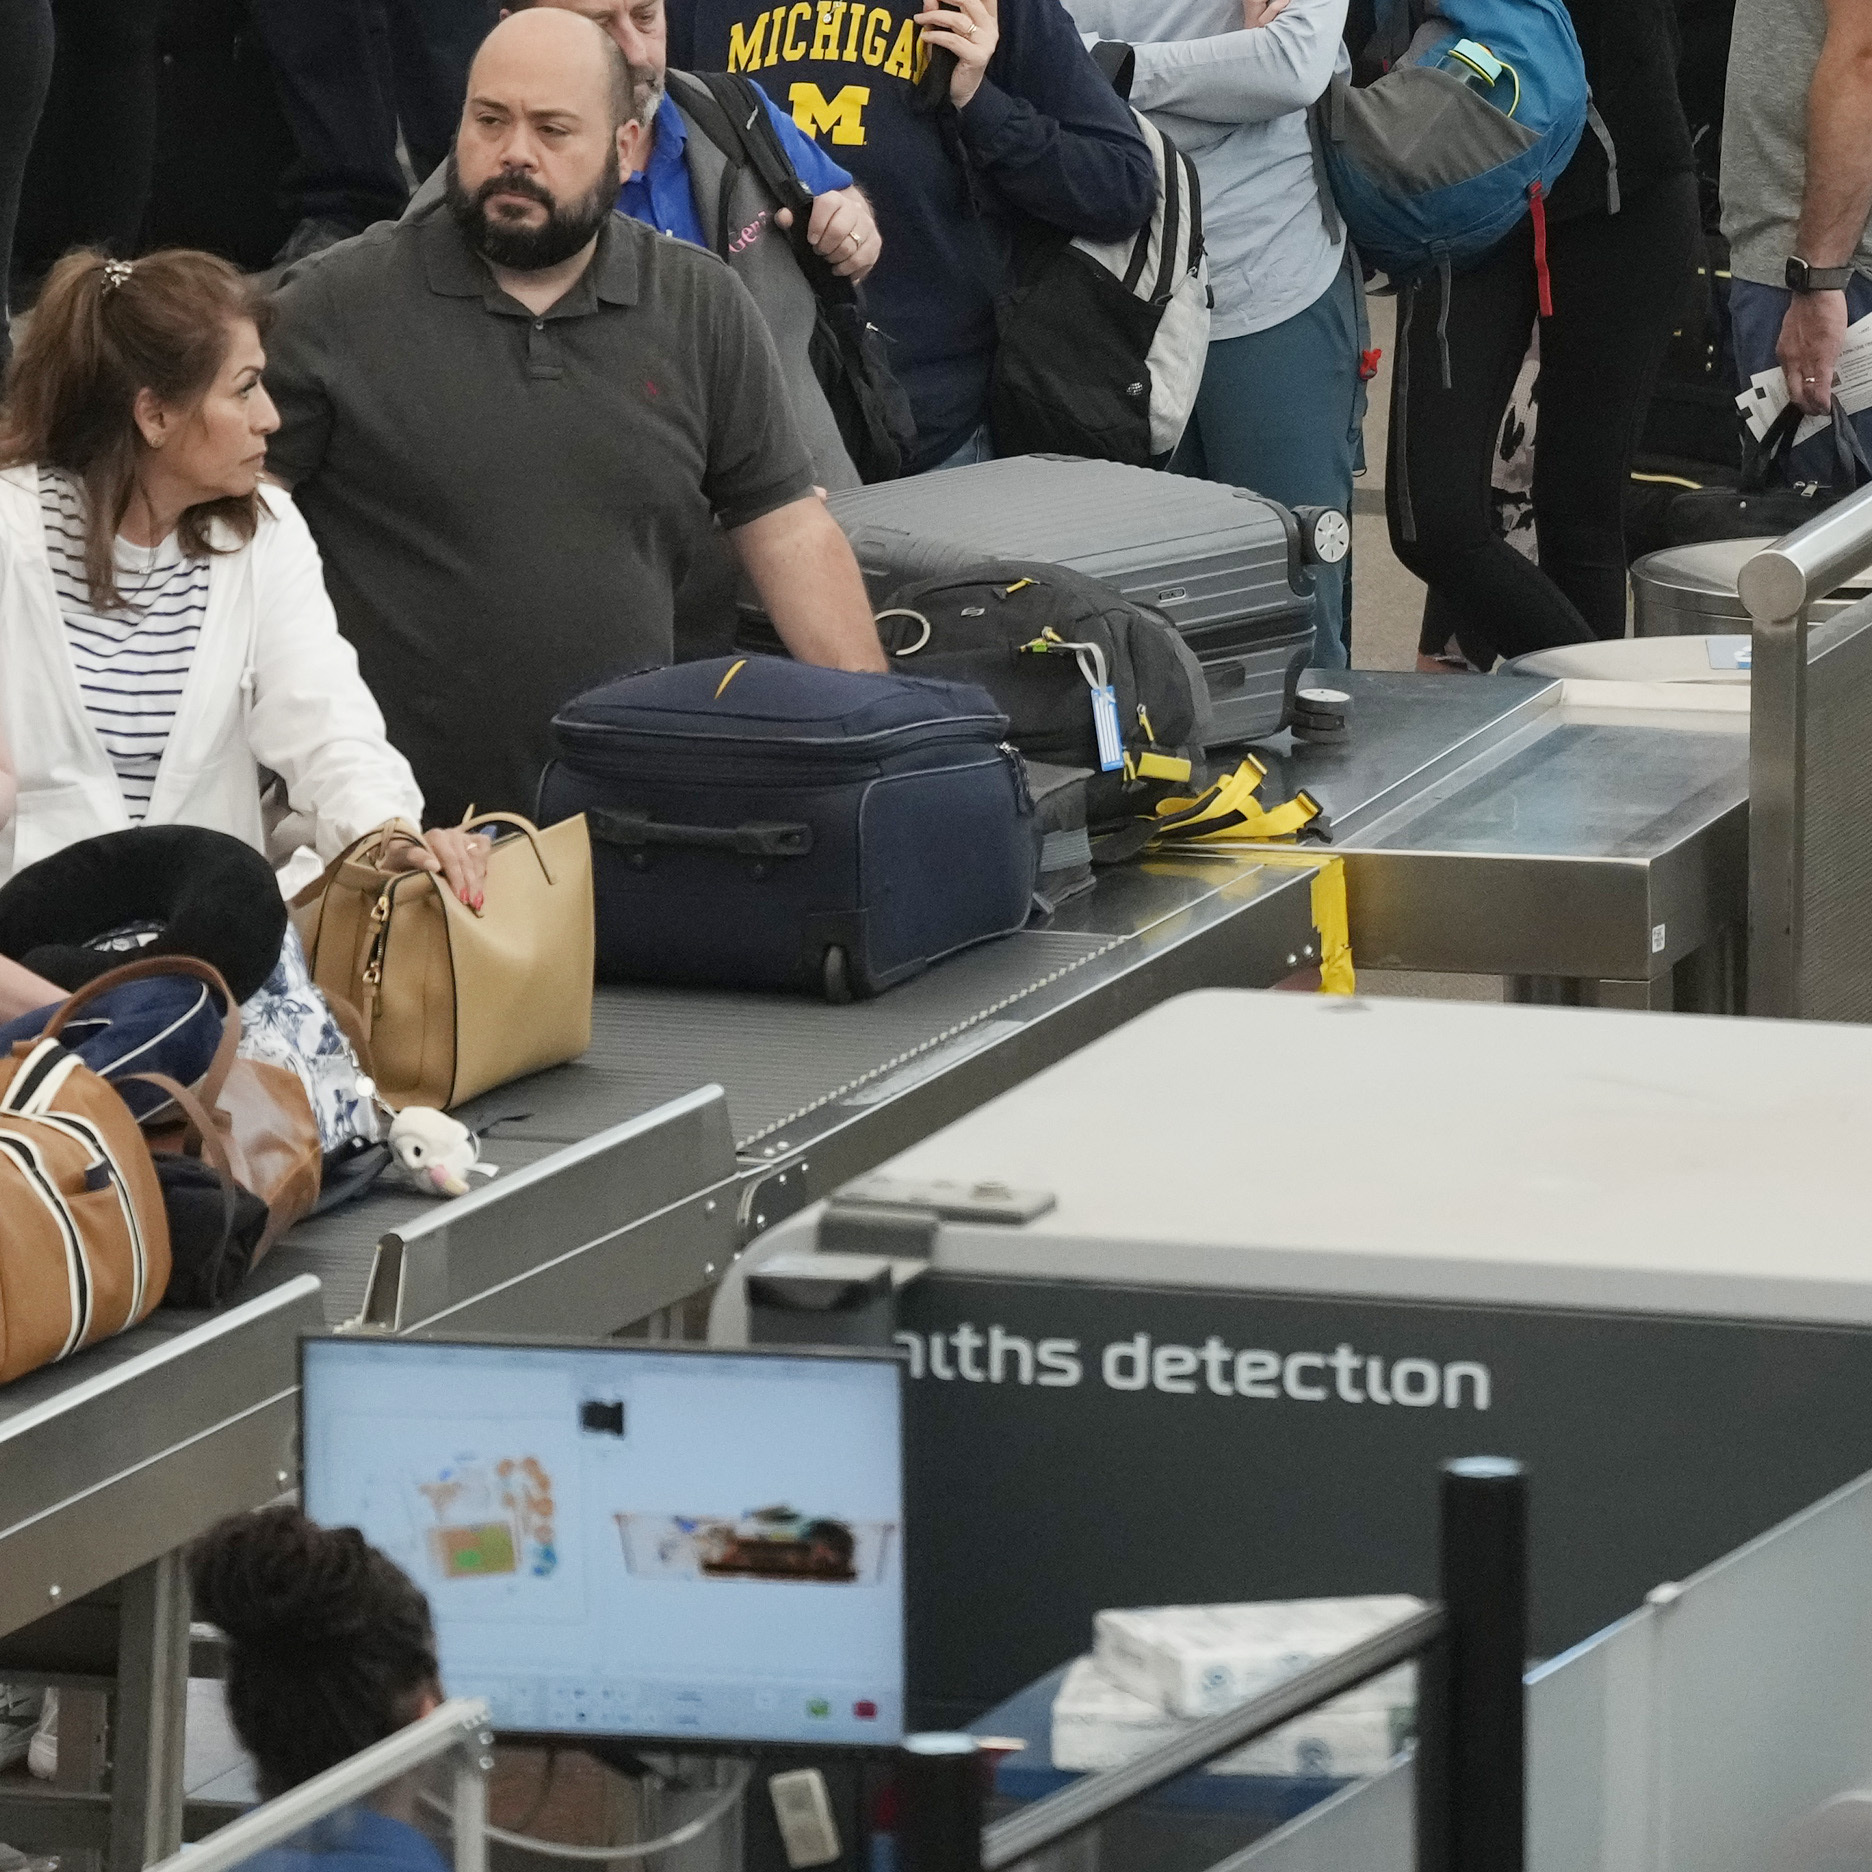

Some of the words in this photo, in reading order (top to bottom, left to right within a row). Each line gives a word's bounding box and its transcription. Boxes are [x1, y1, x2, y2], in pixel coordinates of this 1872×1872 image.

[788, 81, 871, 146] M
[893, 1323, 1083, 1388] iths
[1101, 1330, 1492, 1411] detection
